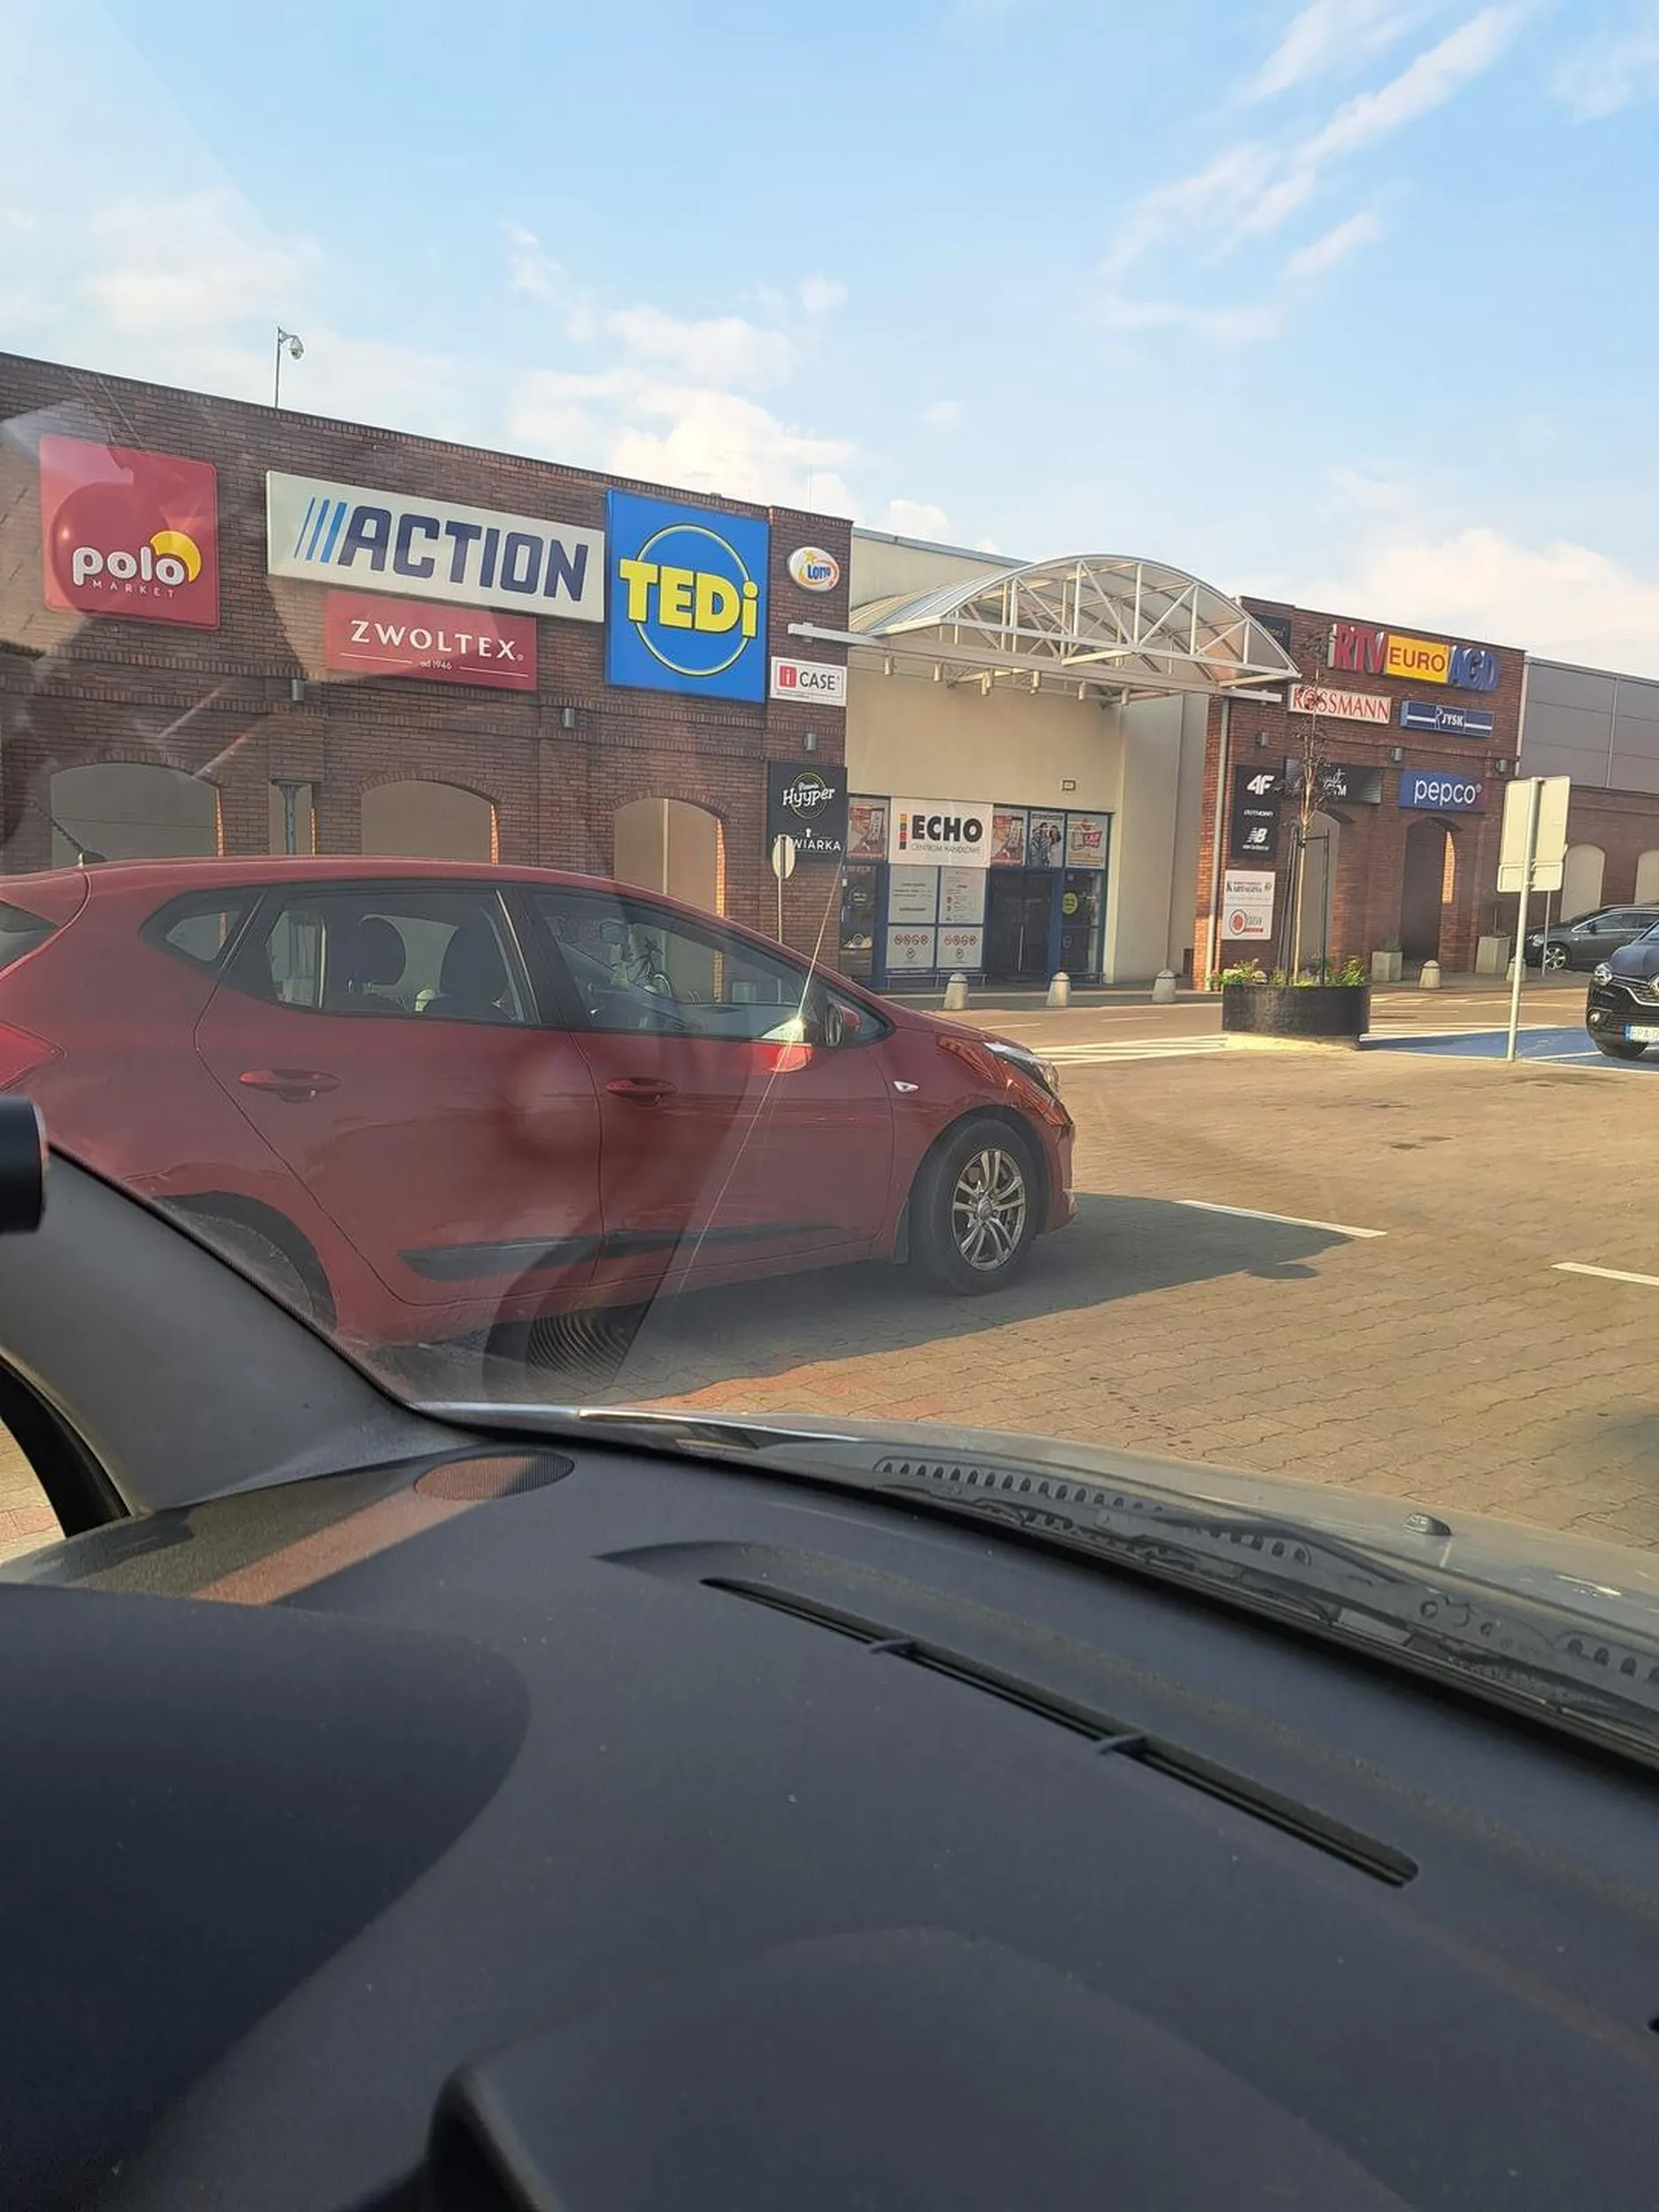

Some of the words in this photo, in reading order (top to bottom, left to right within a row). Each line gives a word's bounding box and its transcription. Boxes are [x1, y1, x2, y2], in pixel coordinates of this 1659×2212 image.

[73, 547, 185, 586] polo
[338, 505, 588, 602] ACTION
[92, 580, 174, 598] MARKET
[620, 559, 758, 638] TEDi
[350, 619, 516, 661] ZWOLTEX
[1328, 624, 1386, 675] RTV
[1388, 647, 1447, 672] EURO
[799, 672, 835, 690] CASE
[1293, 687, 1389, 720] ROSSMANN
[1441, 713, 1463, 726] JYSK
[782, 787, 835, 807] Hyyper
[1247, 774, 1274, 795] 4F
[1414, 780, 1476, 806] pepco
[911, 815, 983, 843] ECHO
[775, 836, 841, 851] WIARKA
